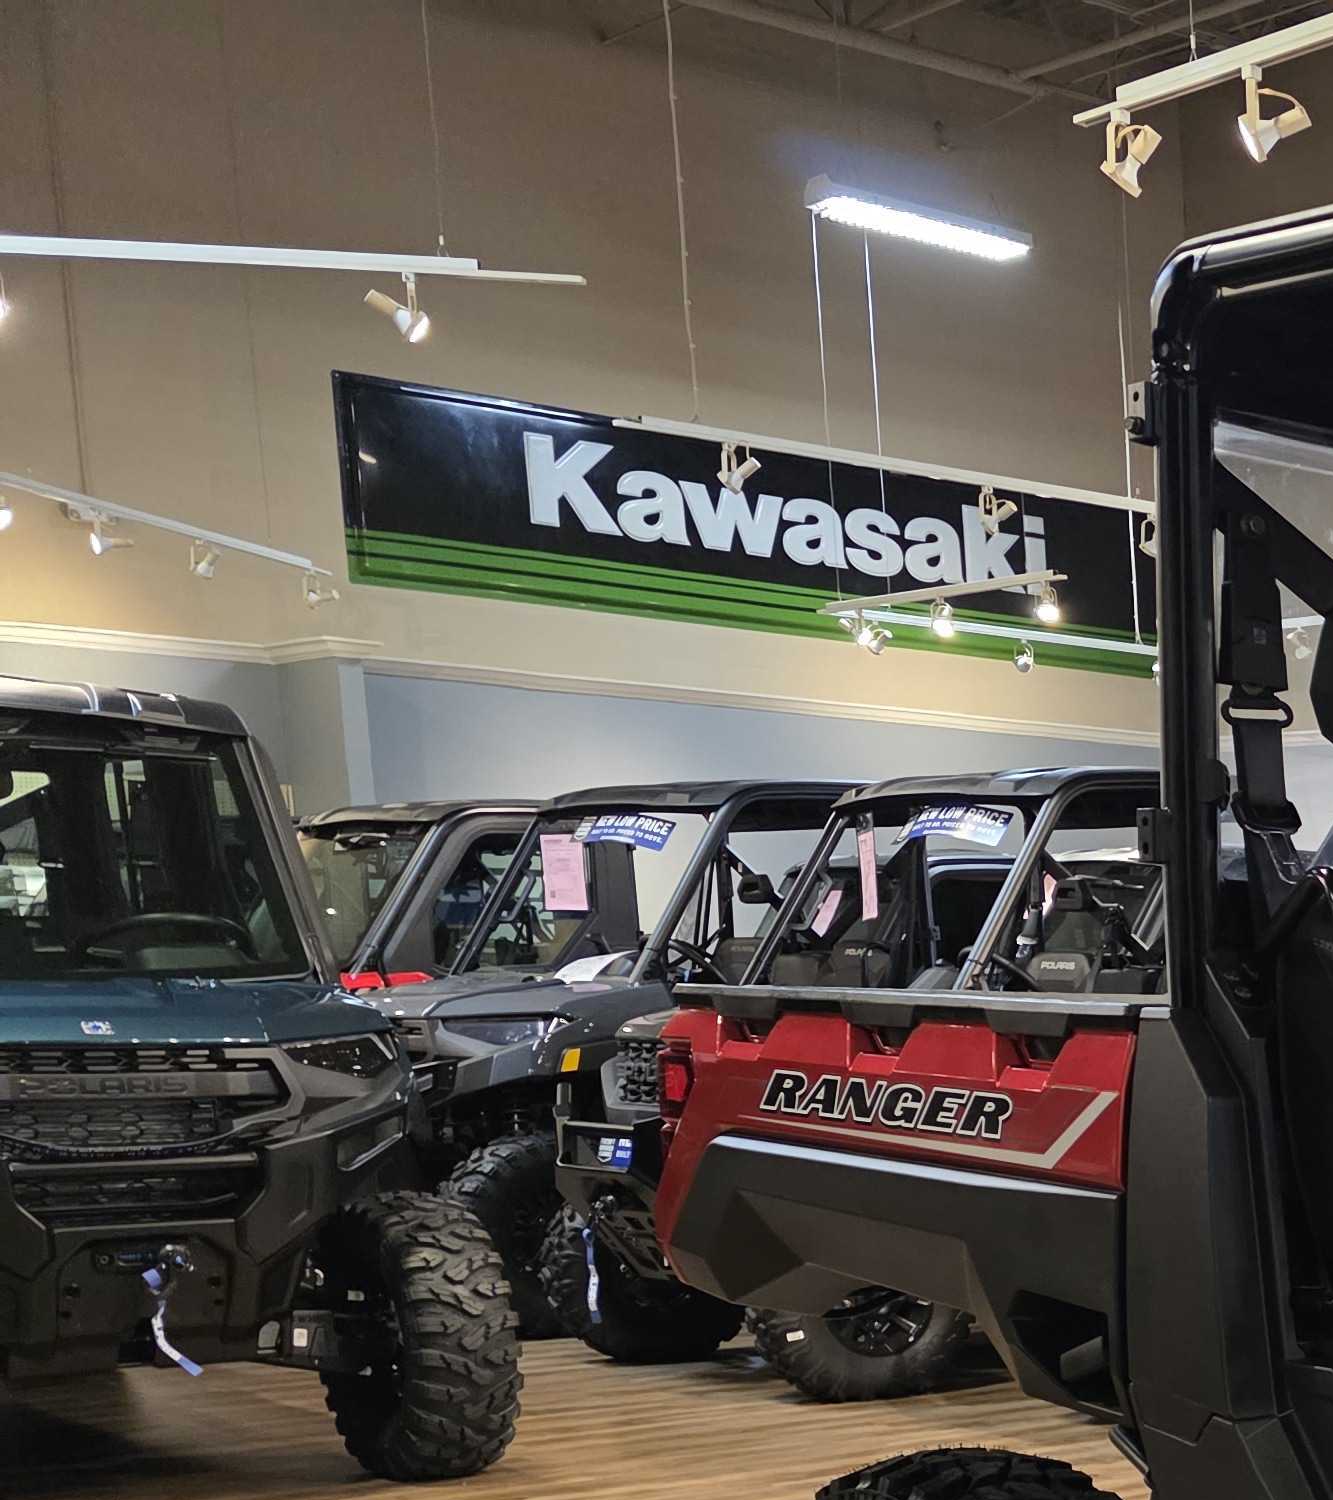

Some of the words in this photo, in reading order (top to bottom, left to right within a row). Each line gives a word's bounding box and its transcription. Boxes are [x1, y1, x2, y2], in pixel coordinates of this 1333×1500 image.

[523, 431, 1048, 595] Kawasaki
[614, 816, 638, 827] LOW
[635, 817, 673, 836] PRICE
[964, 807, 1009, 827] PRICE
[1040, 960, 1076, 971] POLARIS
[19, 1074, 188, 1098] POLARIS
[760, 1068, 1013, 1139] RANGER
